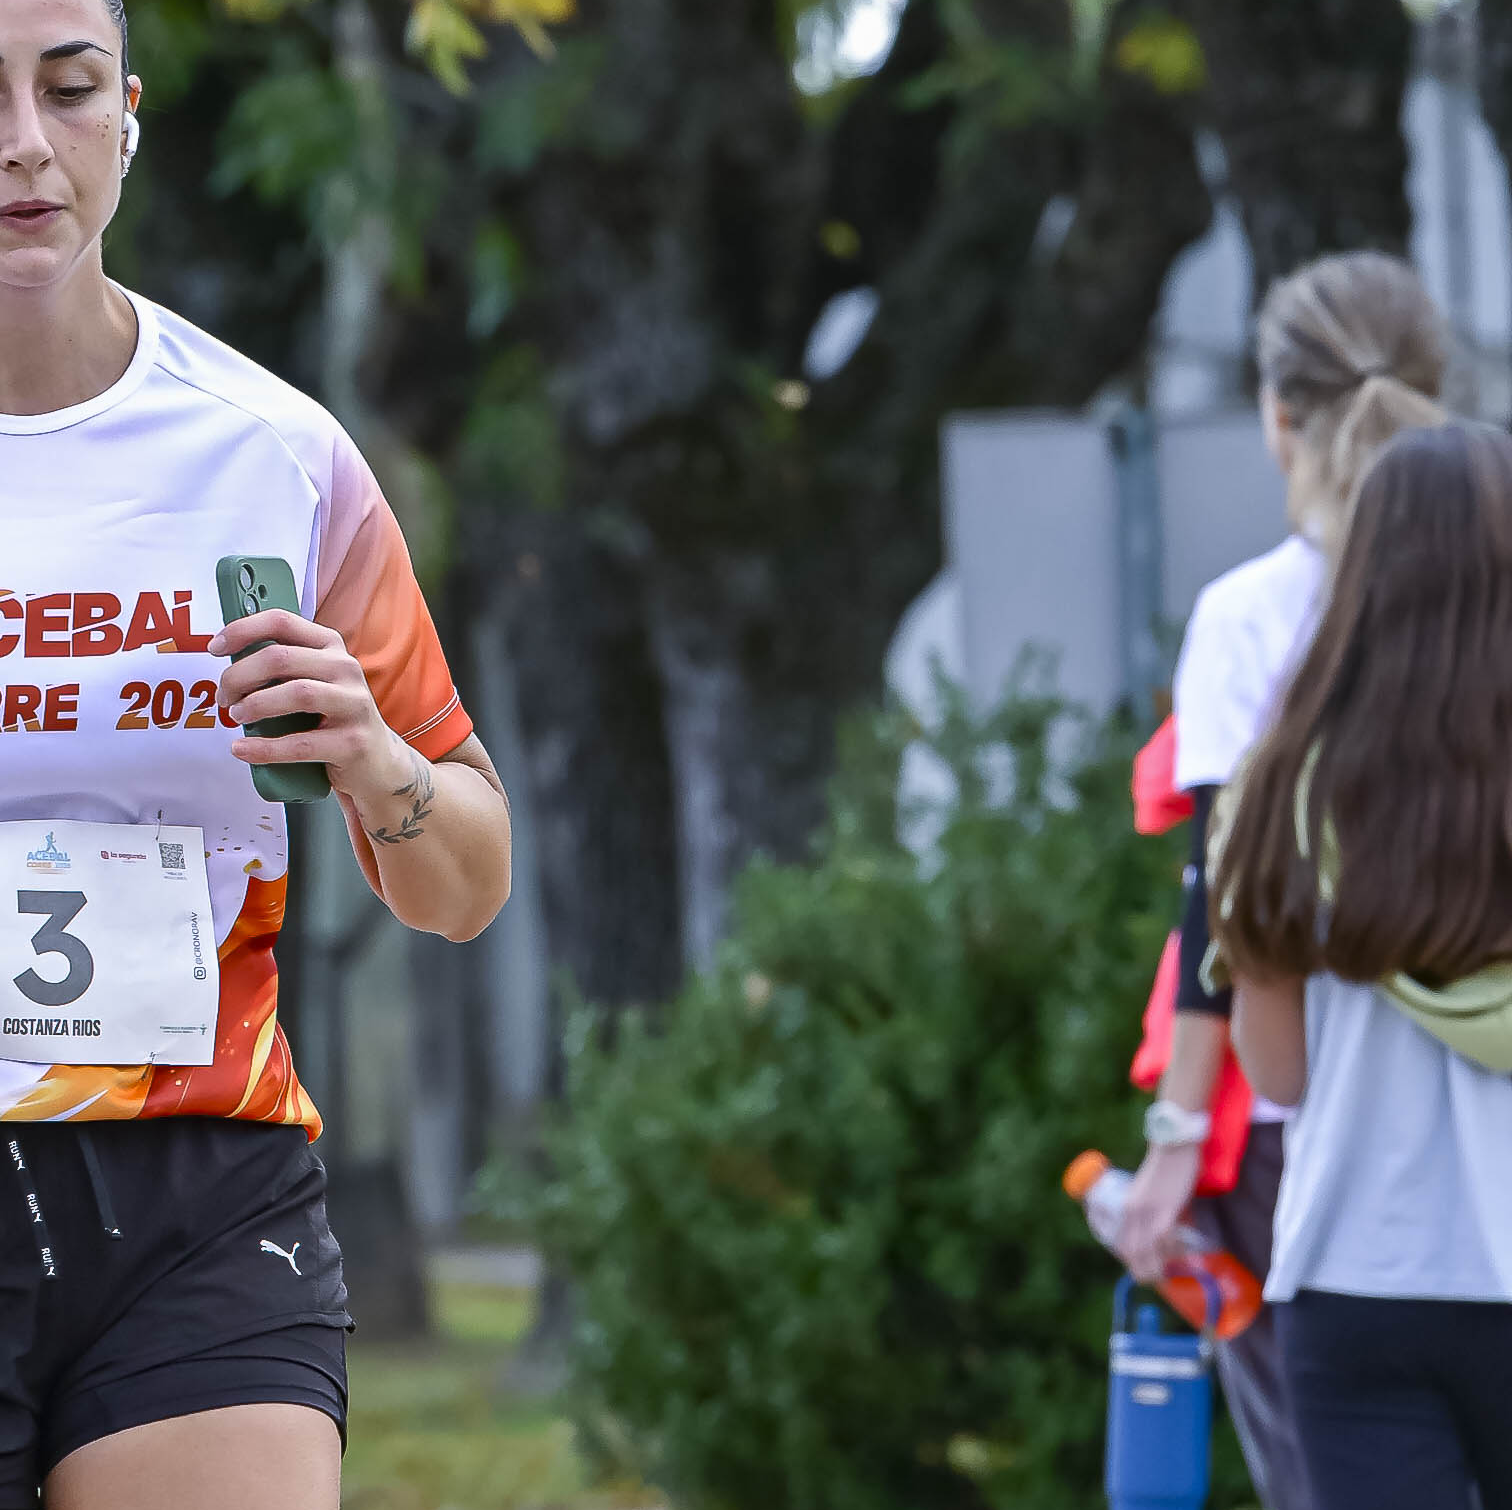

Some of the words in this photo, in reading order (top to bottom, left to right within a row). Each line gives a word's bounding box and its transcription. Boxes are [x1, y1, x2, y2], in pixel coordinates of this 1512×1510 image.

[13, 889, 94, 1006] 3
[3, 1017, 69, 1036] COSTANZA
[72, 1019, 101, 1037] RIOS
[9, 1140, 21, 1161] RUN
[27, 1193, 39, 1213] RUN
